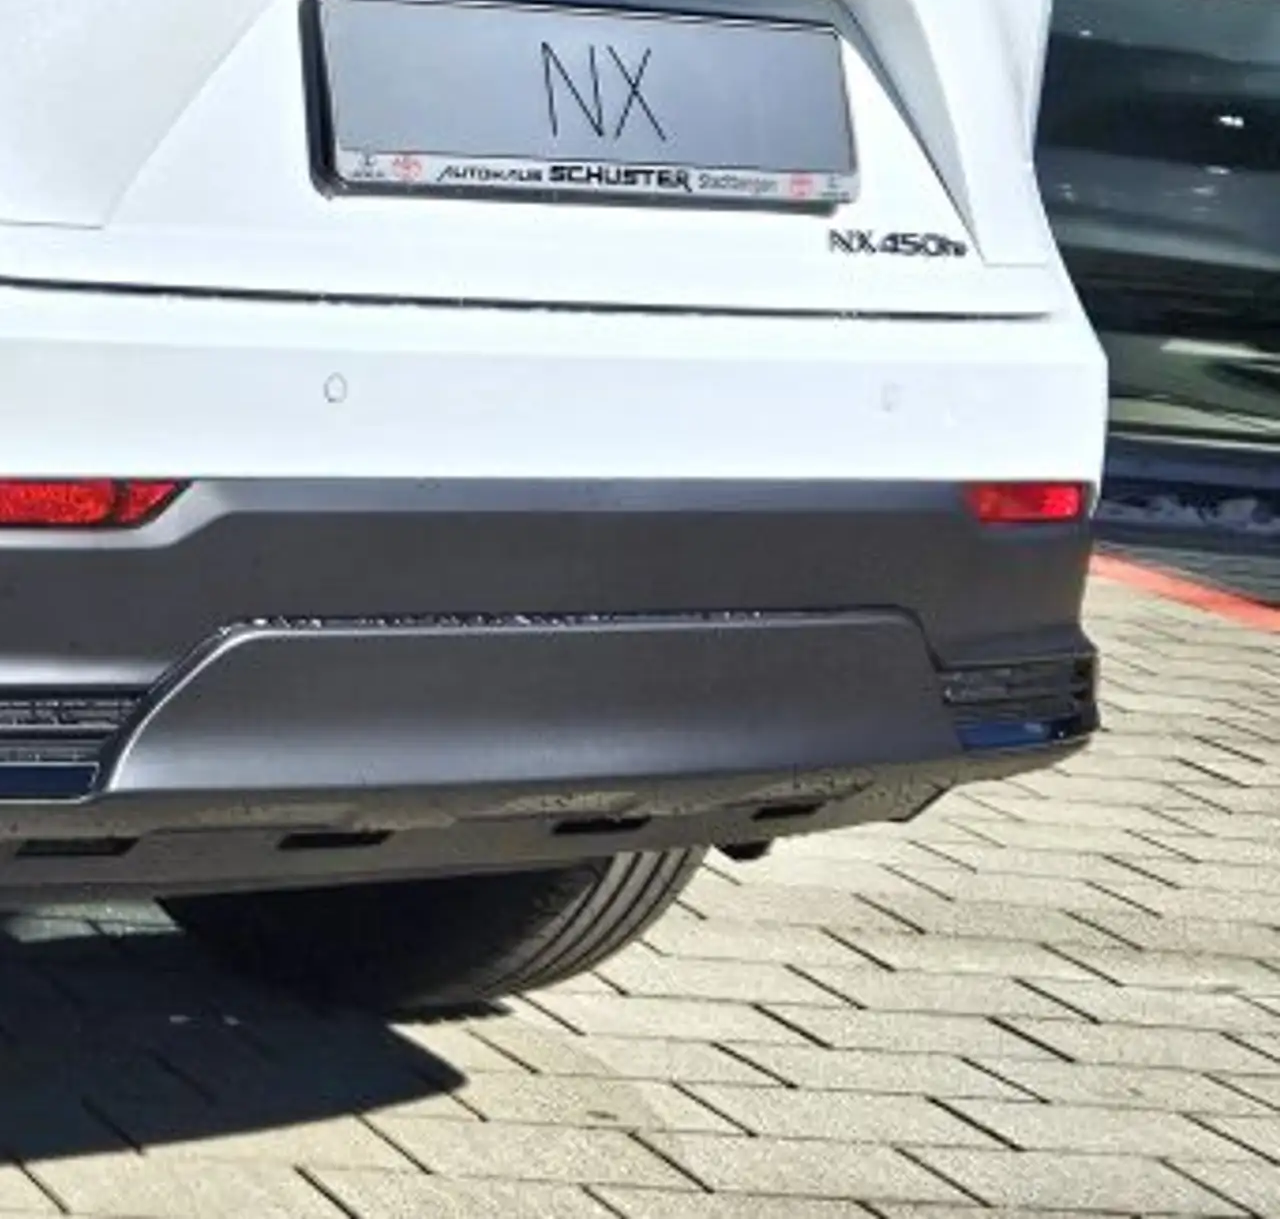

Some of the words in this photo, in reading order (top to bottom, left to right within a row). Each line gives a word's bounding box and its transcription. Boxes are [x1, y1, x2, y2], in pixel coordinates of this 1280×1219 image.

[541, 40, 668, 142] NX
[437, 164, 544, 183] AUTOHAUS
[546, 164, 694, 193] SCHUSTER
